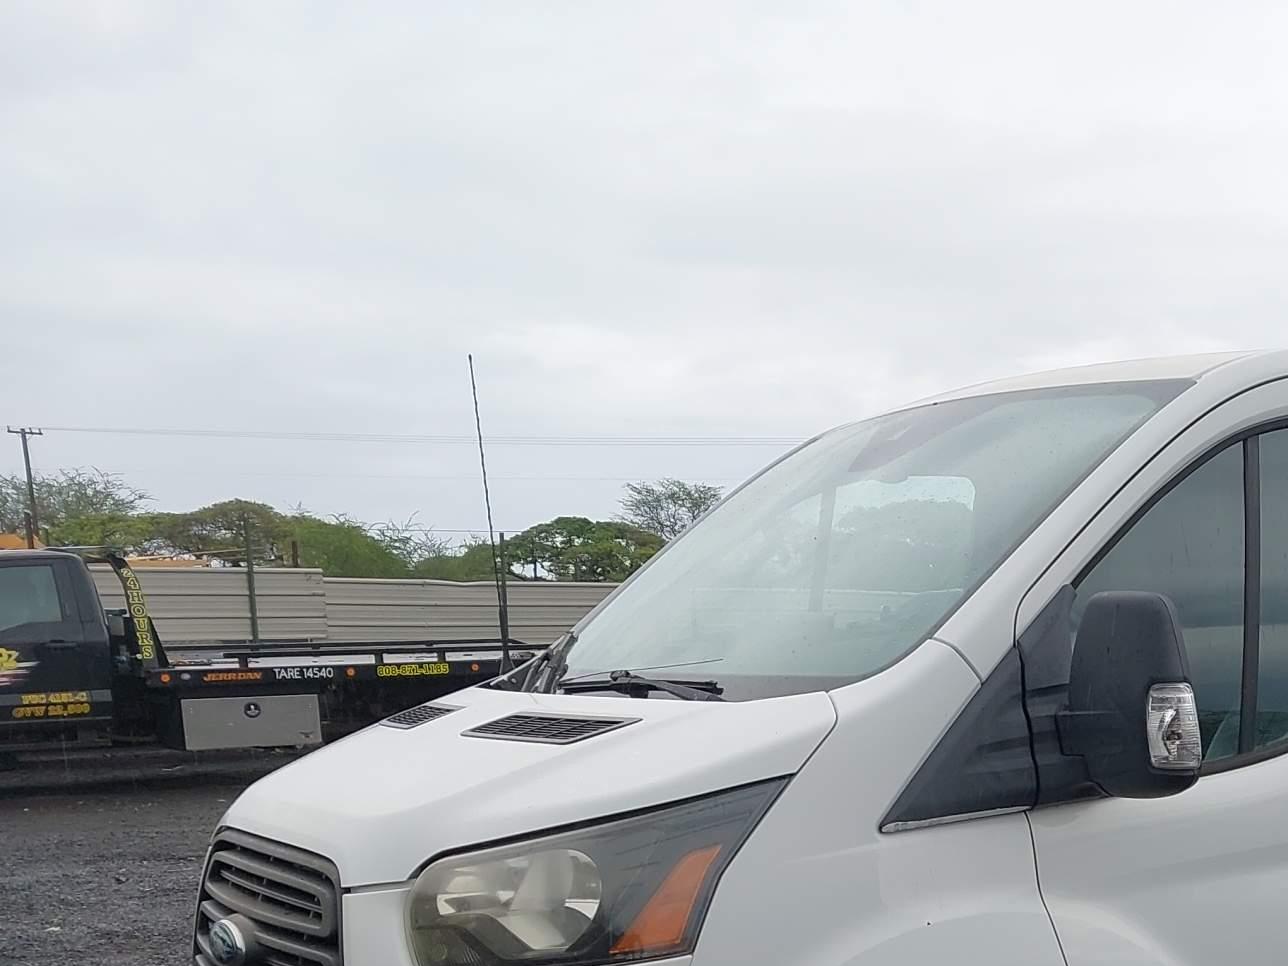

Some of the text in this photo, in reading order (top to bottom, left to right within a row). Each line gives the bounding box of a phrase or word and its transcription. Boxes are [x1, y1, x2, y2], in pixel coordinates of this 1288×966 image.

[273, 667, 334, 679] TARE 14540
[376, 663, 450, 677] 808-871-1185
